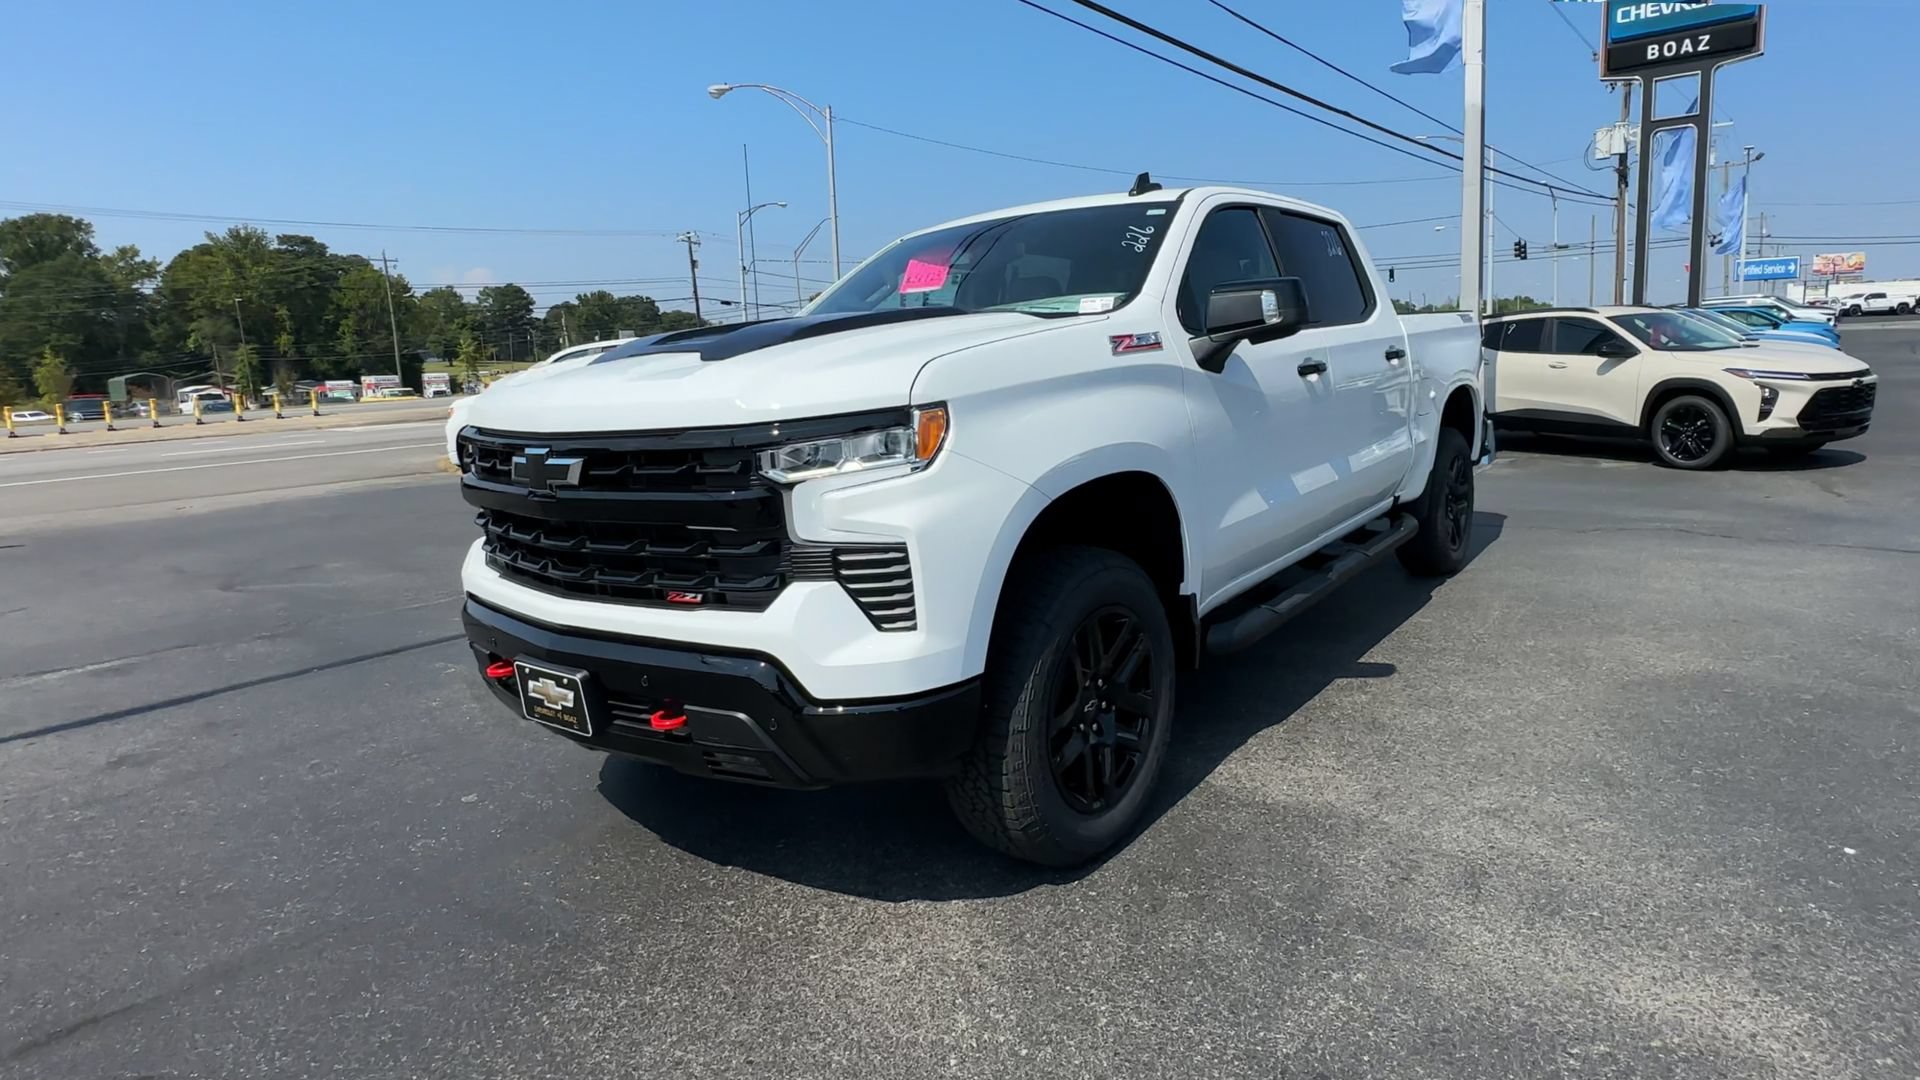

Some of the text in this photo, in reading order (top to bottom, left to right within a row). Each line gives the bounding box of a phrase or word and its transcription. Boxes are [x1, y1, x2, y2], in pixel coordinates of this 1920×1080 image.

[1617, 2, 1712, 23] CHEVR
[1647, 35, 1711, 60] BOAZ
[1121, 225, 1155, 253] 226
[1764, 263, 1785, 274] Service
